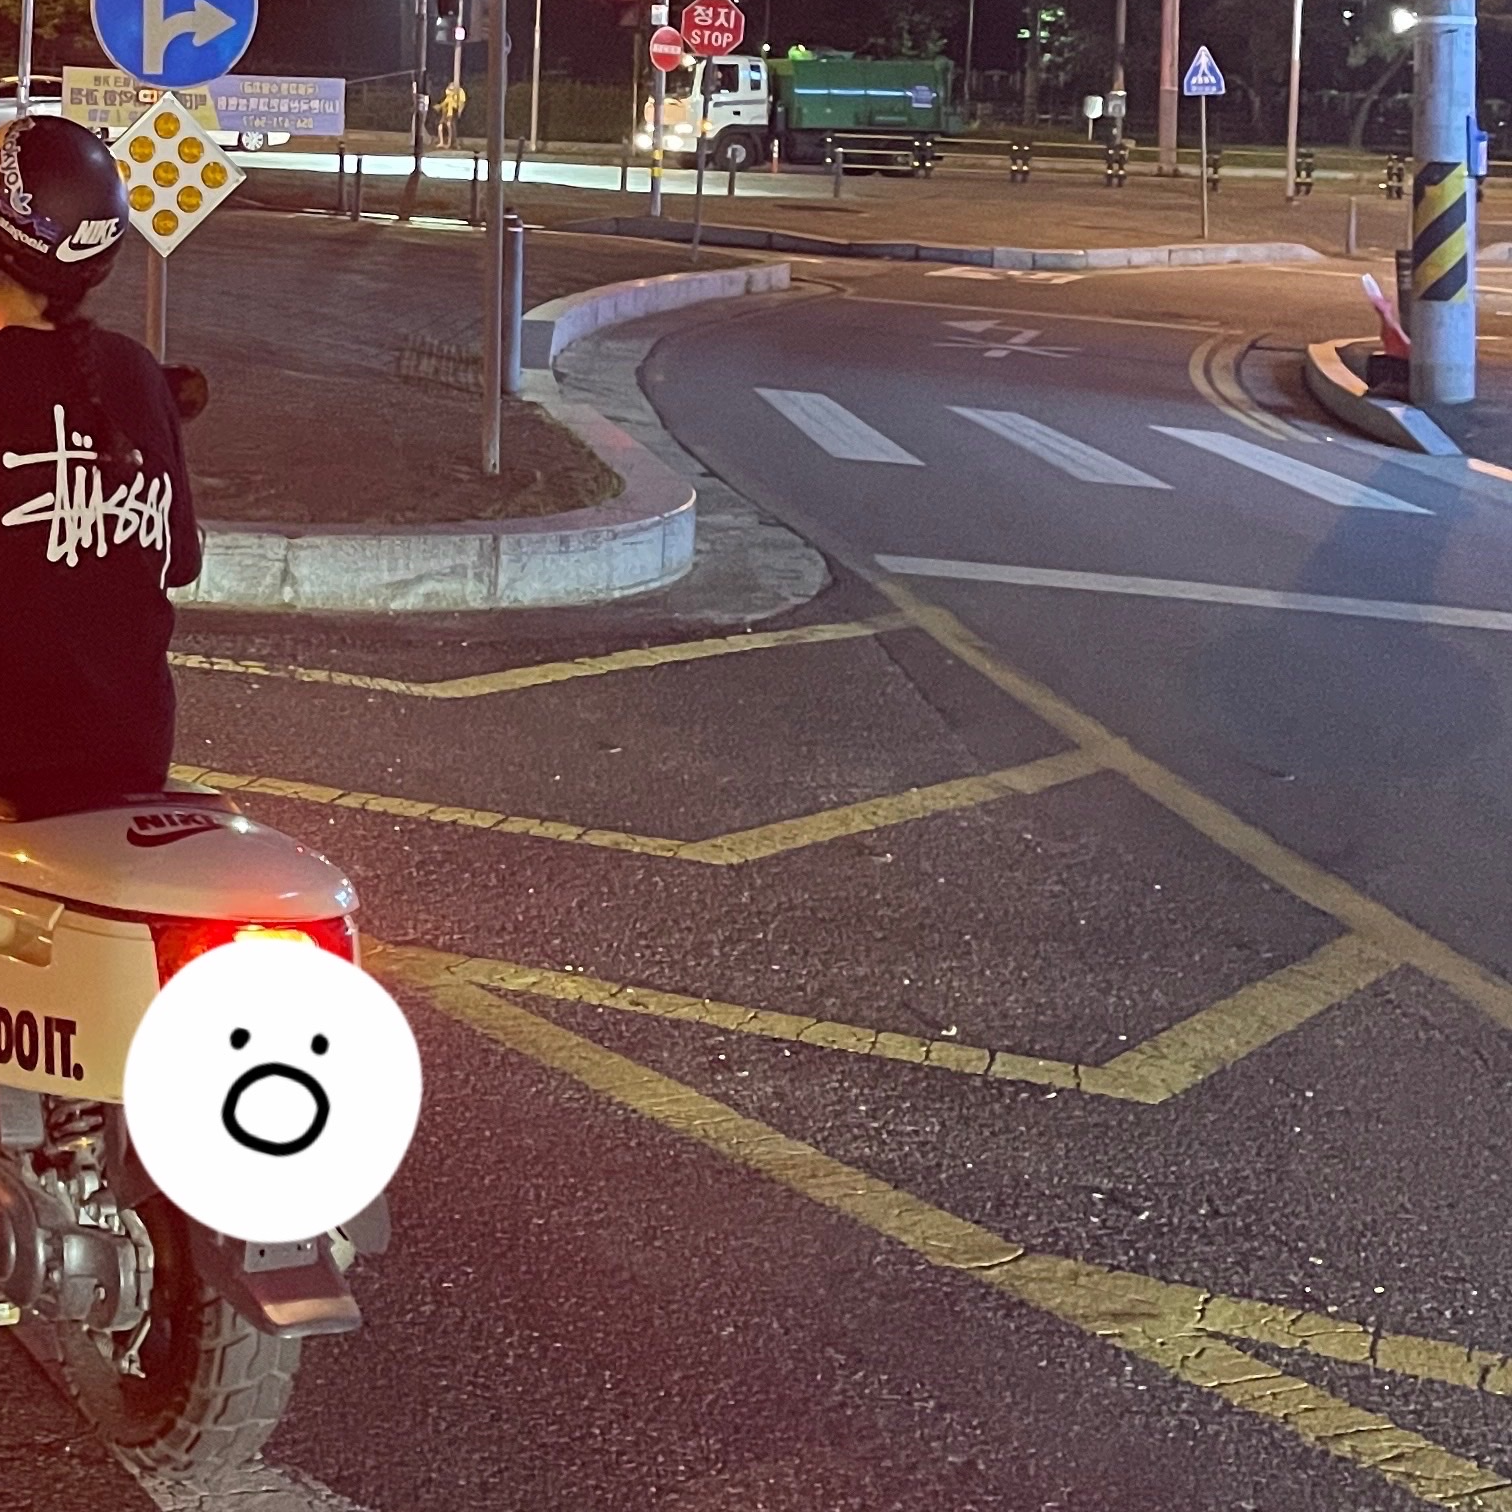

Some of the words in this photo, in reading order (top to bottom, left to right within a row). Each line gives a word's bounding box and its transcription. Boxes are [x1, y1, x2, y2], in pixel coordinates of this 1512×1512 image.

[693, 5, 736, 29] 정지
[690, 29, 734, 48] STOP
[71, 217, 120, 245] NIKE
[44, 1016, 84, 1081] IT.
